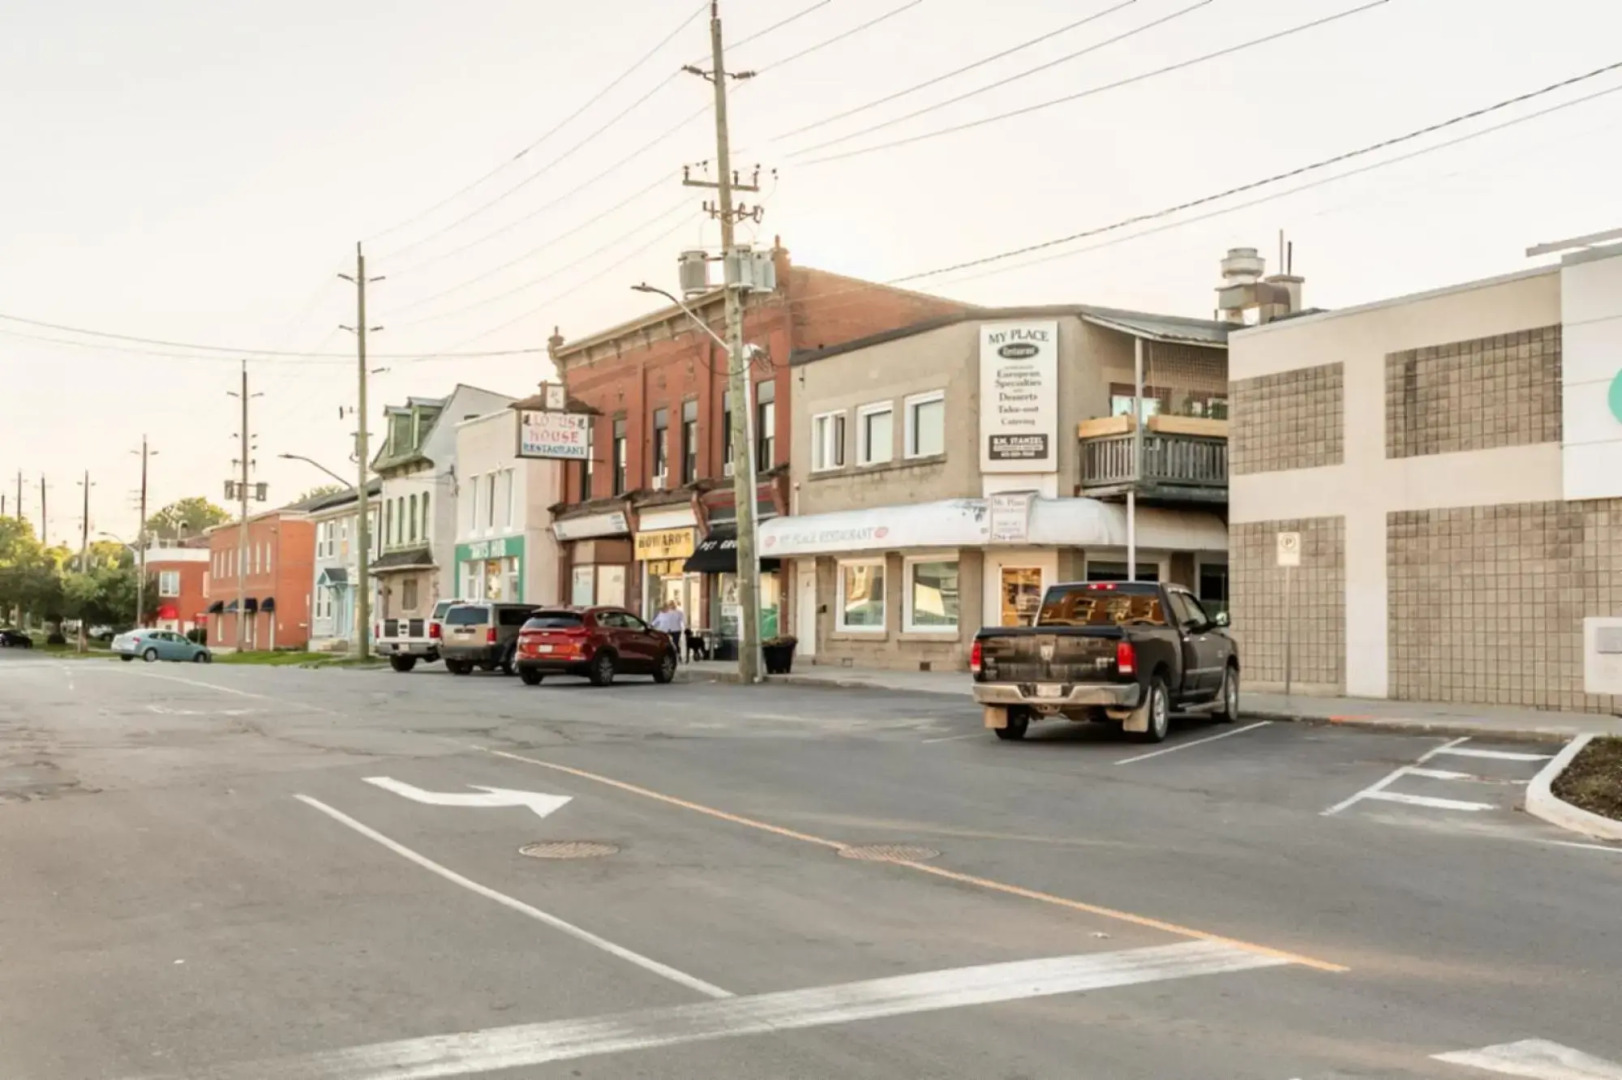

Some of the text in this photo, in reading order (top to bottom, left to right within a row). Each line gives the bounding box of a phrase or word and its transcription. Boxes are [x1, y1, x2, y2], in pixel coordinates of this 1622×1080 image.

[988, 329, 1049, 344] MY PLACE
[997, 370, 1040, 379] European
[995, 379, 1042, 388] Specialties
[999, 393, 1038, 401] Desserts
[529, 429, 579, 443] HOUSE
[522, 443, 585, 455] RESTAURANT
[819, 527, 875, 543] RESTAURANT
[701, 541, 717, 551] PET
